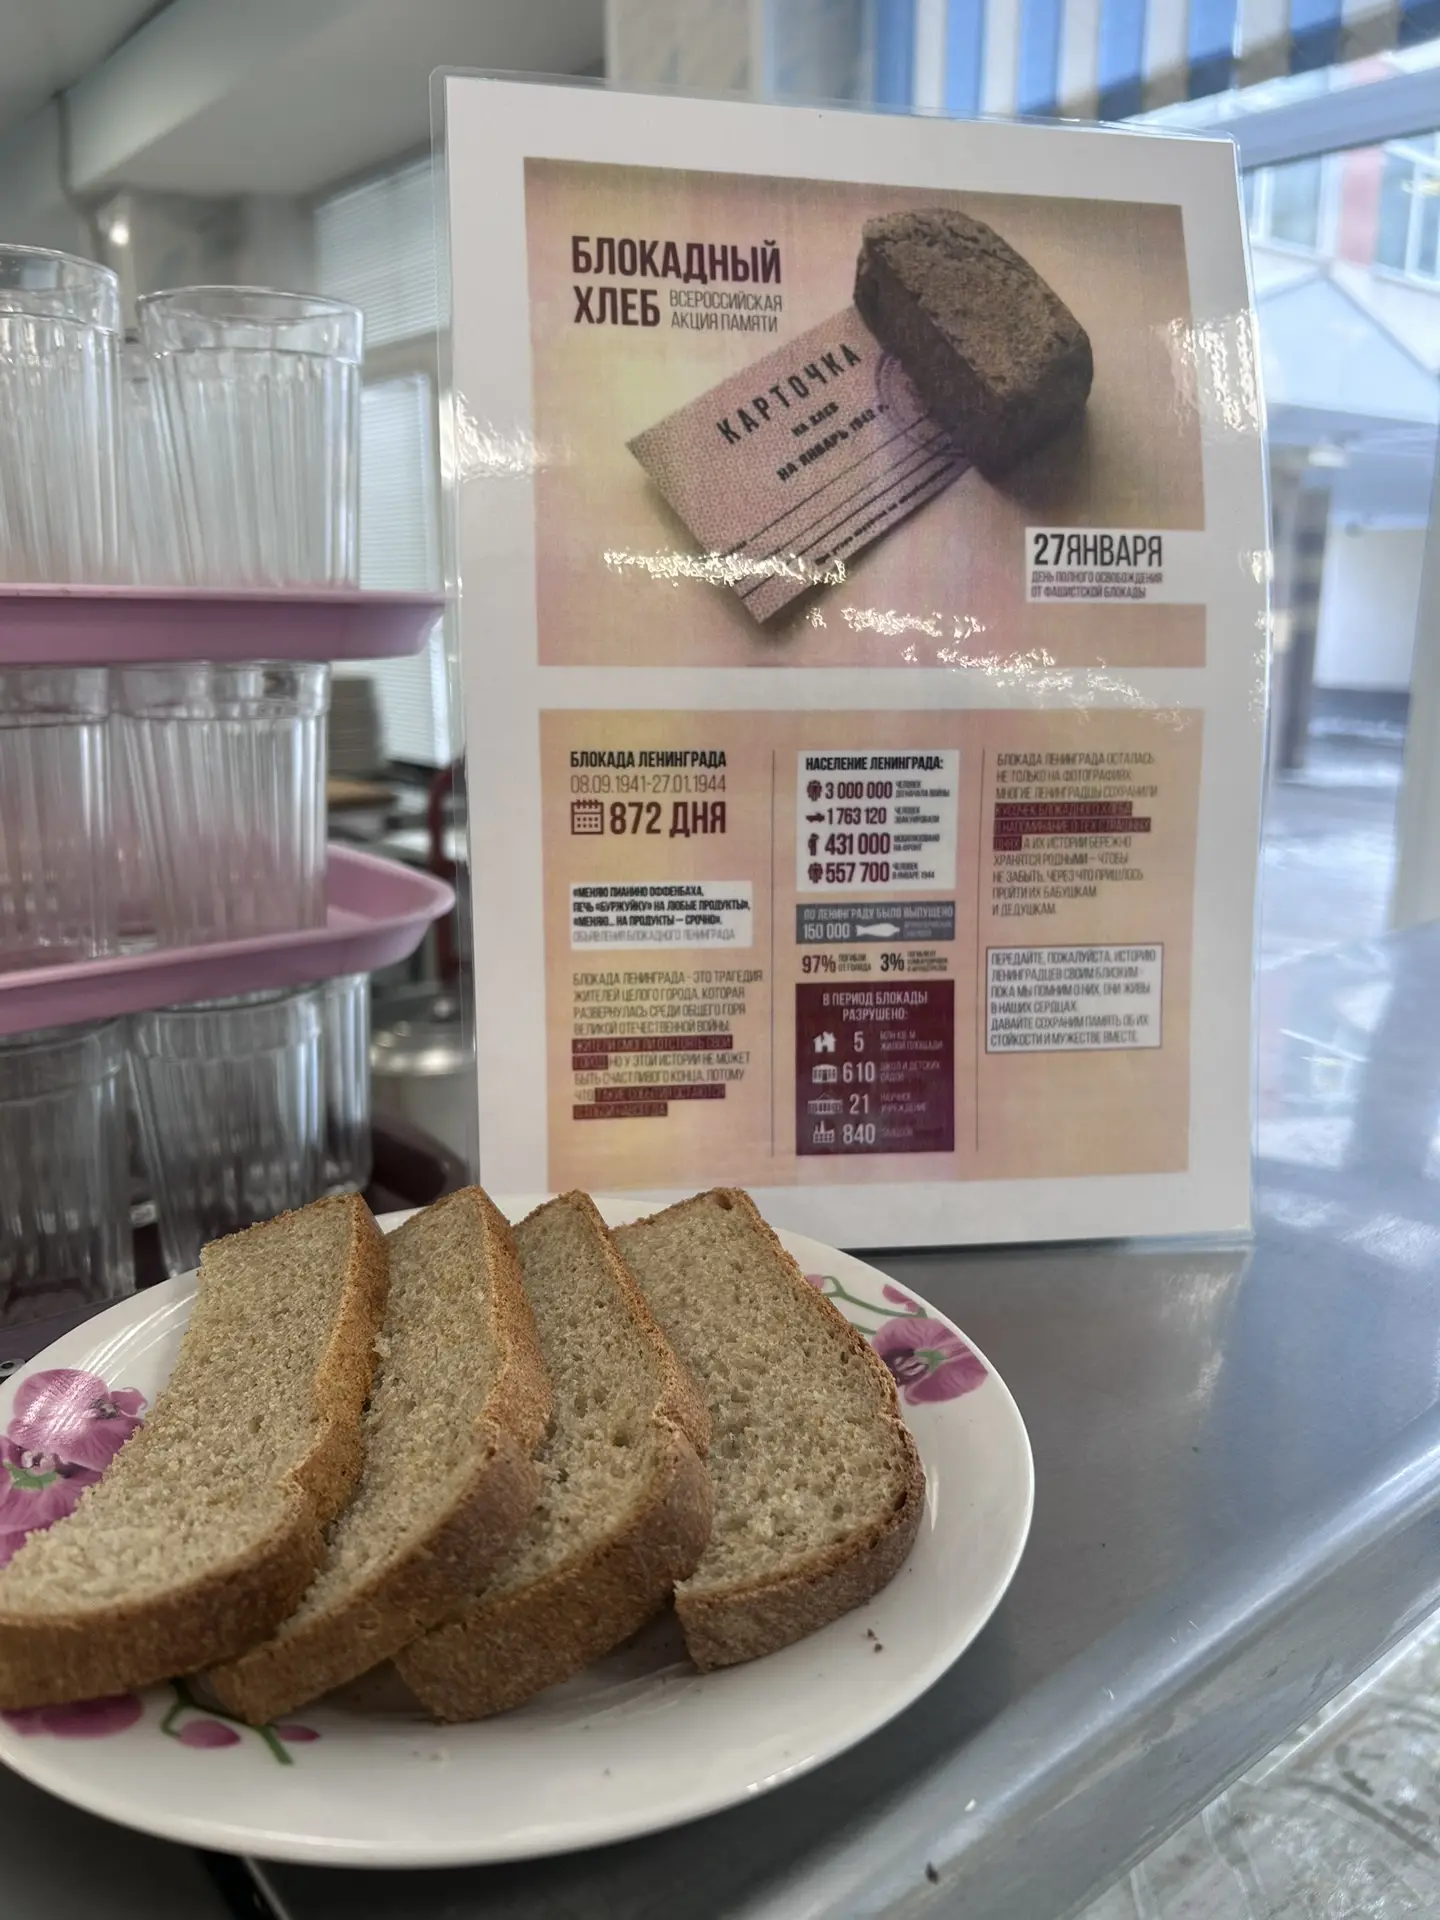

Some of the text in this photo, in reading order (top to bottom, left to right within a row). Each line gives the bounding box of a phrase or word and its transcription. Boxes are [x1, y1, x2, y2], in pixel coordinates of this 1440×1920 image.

[571, 235, 782, 284] БЛОКАДНЫЙ
[573, 286, 661, 327] ХЛЕБ
[669, 290, 782, 312] ВСЕРОССИЙСКАЯ
[671, 311, 778, 332] АКЦИЯ ПАМЯТИ
[716, 344, 862, 445] КАРТОЧКА
[776, 462, 798, 481] НА
[1031, 571, 1163, 584] ДЕНЬ ПОЛНОГО ОСВОБОЖДЕНИЯ
[1031, 585, 1146, 599] ОТ ФАШИСТСКОЙ БЛОКАДЫ
[570, 751, 726, 769] БЛОКАДА ЛЕНИНГРАДА
[806, 755, 943, 771] НАСЕЛЕНИЕ ЛЕНИНГРАДА:
[997, 752, 1155, 766] БЛОКАДА ЛЕНИНГРАДА ОСТАЛАСЬ
[996, 770, 1008, 783] НЕ
[1010, 769, 1047, 782] ТОЛЬКО
[825, 781, 892, 799] 3 000 000
[995, 784, 1158, 799] МНОГИЕ ЛЕНИНГРАДЦЫ СОХРАНИЛИ
[610, 801, 726, 838] 872 ДНЯ
[836, 807, 862, 825] 763
[865, 806, 887, 825] 120
[825, 832, 890, 856] 431 000
[1032, 837, 1046, 849] ИХ
[1047, 836, 1089, 849] ИСТОРИИ
[1089, 835, 1132, 848] БЕРЕЖНО
[993, 851, 1128, 866] ХРАНЯТСЯ РОДНЫМИ ЧТОБЫ
[825, 861, 889, 883] 557 700
[992, 869, 1002, 883] НЕ
[1046, 869, 1075, 882] ЧЕРЕЗ
[1075, 868, 1095, 881] ЧТО
[1095, 868, 1143, 882] ПРИШЛОСЬ
[610, 886, 647, 897] ПИАНИНО
[992, 885, 1097, 899] ПРОЙТИ ИХ БАБУШКАМ
[573, 901, 594, 912] ПЕЧЬ
[653, 900, 665, 911] НА
[667, 900, 697, 911] ЛЮБЫЕ
[817, 907, 874, 921] ЛЕНИНГРАДУ
[876, 906, 902, 919] БЫЛО
[903, 905, 953, 918] ВЫПУЩЕНО
[992, 903, 999, 916] И
[616, 915, 628, 926] НА
[629, 915, 675, 926] ПРОДУКТЫ
[804, 922, 850, 940] 150 000
[802, 954, 836, 974] 97%
[880, 952, 905, 972] 3%
[1114, 949, 1156, 963] ИСТОРИЮ
[572, 969, 763, 986] БЛОКАДА ЛЕНИНГРАДА ЭТО ТРАГЕДИЯ
[991, 967, 1062, 982] ЛЕНИНГРАДЦЕВ
[1064, 967, 1094, 980] СВОИМ
[573, 988, 620, 1003] ЖИТЕЛЕЙ
[622, 987, 659, 1002] ЦЕЛОГО
[701, 986, 745, 999] КОТОРАЯ
[822, 990, 928, 1006] В ПЕРИОД БЛОКАДЫ
[991, 985, 1015, 999] ПОКА
[1017, 984, 1032, 998] МЫ
[1034, 984, 1072, 997] ПОМНИМ
[1103, 982, 1121, 996] ОНИ
[573, 1002, 746, 1019] РАЗВЕРНУЛАСЬ СРЕДИ ОБЩЕГО ГОРЯ
[842, 1007, 909, 1022] РАЗРУШЕНО:
[991, 1000, 1077, 1014] В НАШИХ СЕРДЦАХ
[573, 1020, 695, 1036] ВЕЛИКОЙ ОТЕЧЕСТВЕННОЙ
[991, 1017, 1033, 1032] ДАВАЙТЕ
[1034, 1015, 1084, 1030] СОХРАНИМ
[1085, 1014, 1122, 1028] ПАМЯТЬ
[853, 1030, 865, 1052] 5
[991, 1032, 1043, 1047] СТОЙКОСТИ
[1052, 1031, 1100, 1045] МУЖЕСТВЕ
[623, 1055, 631, 1067] У
[632, 1054, 658, 1067] ЭТОЙ
[659, 1053, 700, 1067] ИСТОРИИ
[702, 1053, 714, 1065] НЕ
[715, 1051, 750, 1065] МОЖЕТ
[574, 1073, 601, 1086] БЫТЬ
[602, 1071, 669, 1085] СЧАСТЛИВОГО
[706, 1068, 745, 1082] ПОТОМУ
[574, 1088, 595, 1102] ЧТО
[849, 1093, 870, 1115] 21
[842, 1123, 876, 1145] 840
